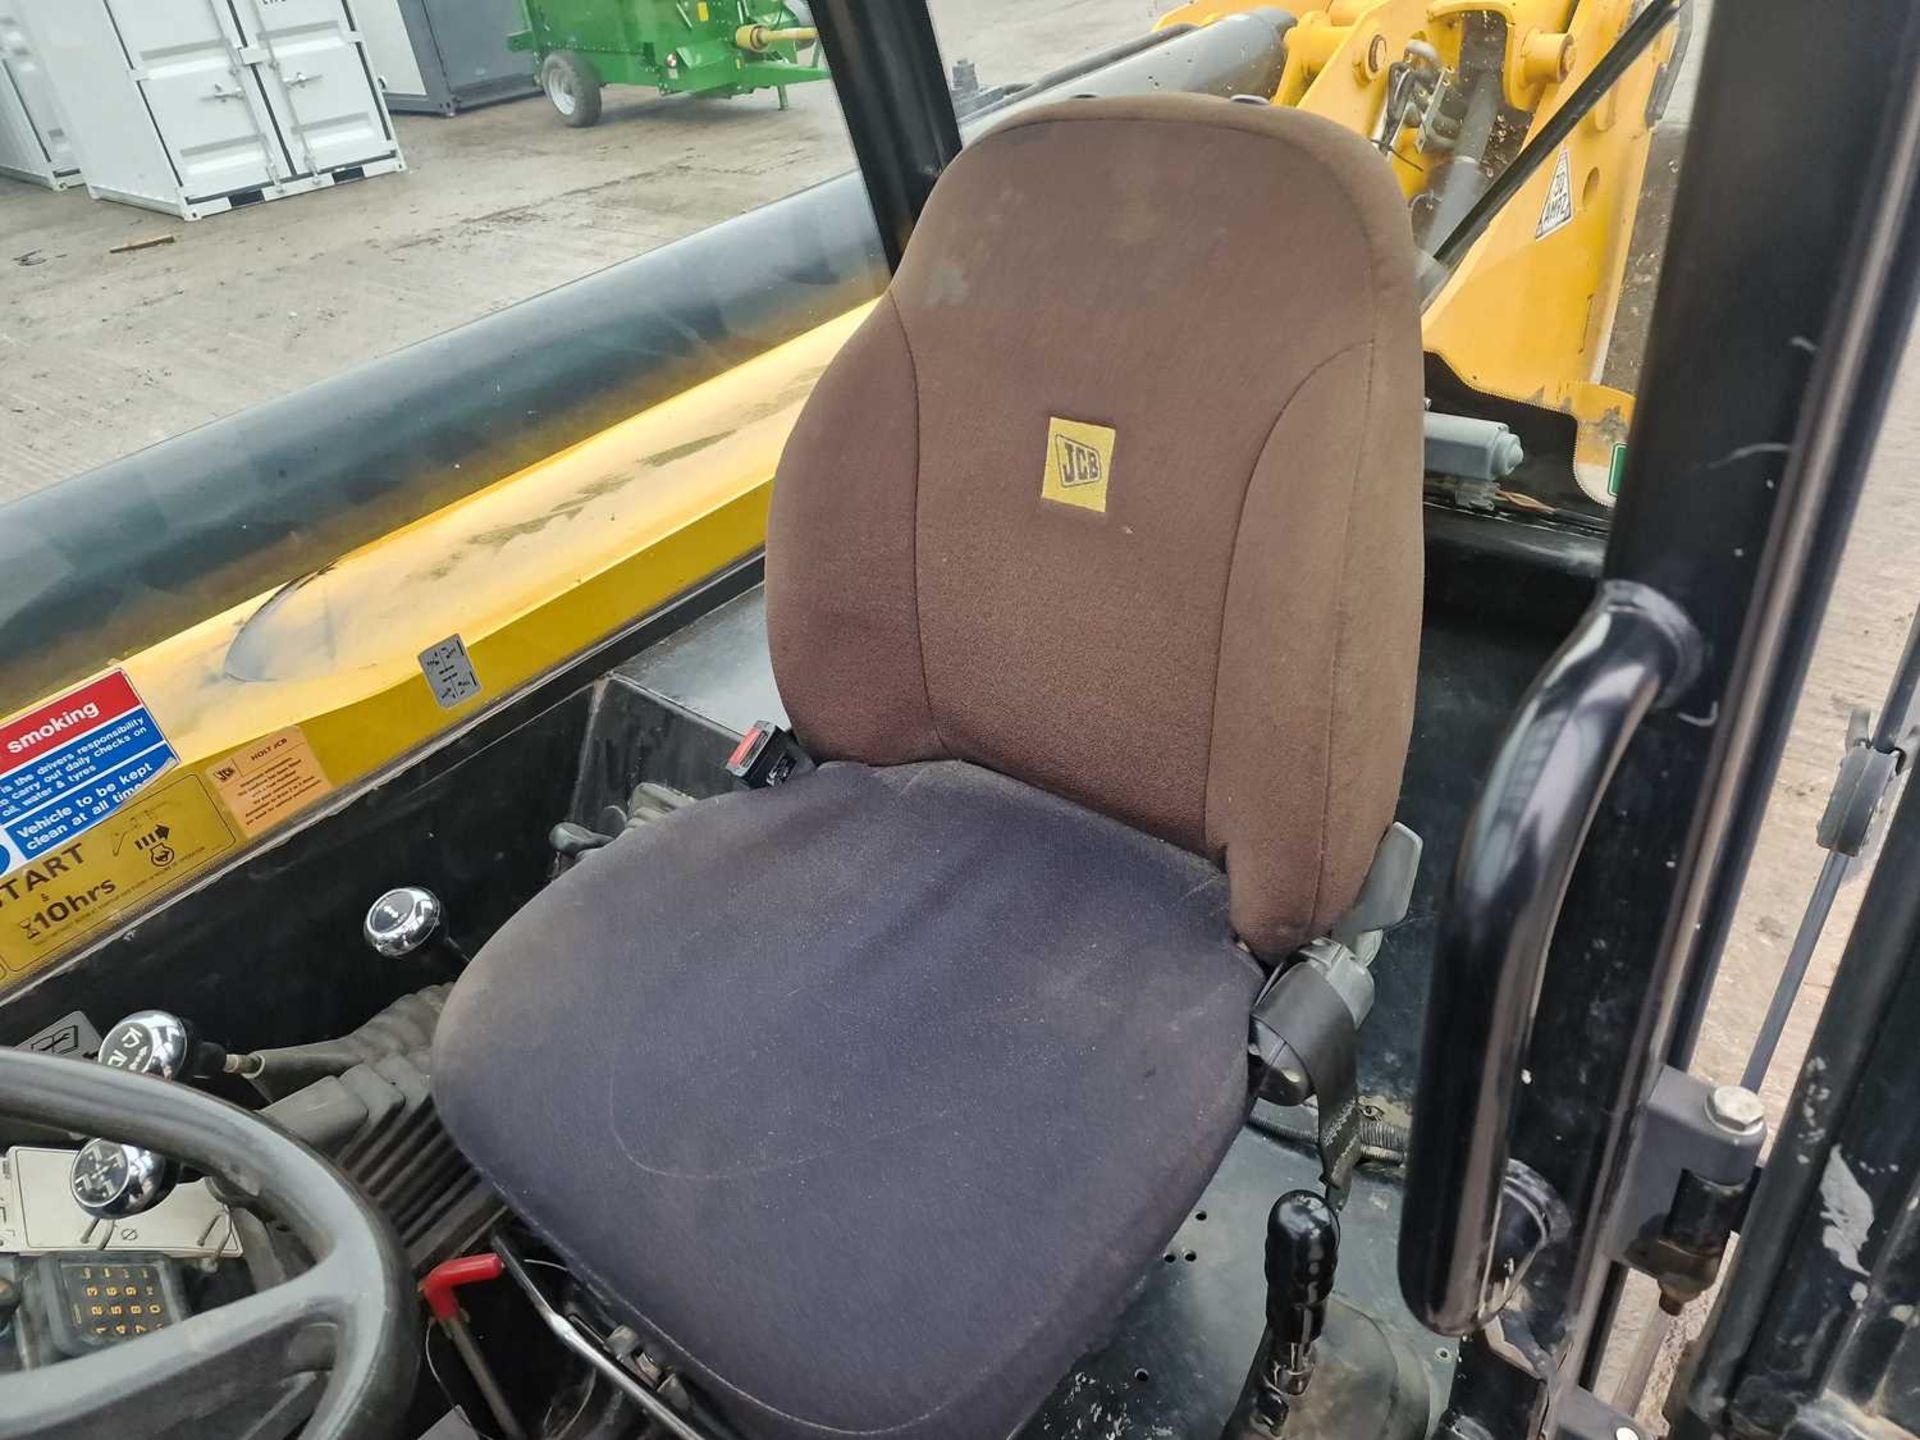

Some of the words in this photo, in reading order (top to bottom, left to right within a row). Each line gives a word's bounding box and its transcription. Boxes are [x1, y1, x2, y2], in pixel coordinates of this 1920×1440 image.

[1062, 441, 1099, 482] JCB
[7, 702, 100, 753] smoking
[12, 781, 41, 799] carry
[44, 769, 63, 783] out
[65, 756, 91, 772] daily
[94, 735, 131, 757] checks
[133, 726, 147, 737] on
[14, 774, 34, 787] the
[37, 753, 74, 775] drivers
[77, 716, 144, 755] responsibility
[250, 746, 272, 761] HOLT
[273, 738, 288, 750] JCB
[16, 807, 72, 838] Vehicle
[76, 796, 93, 808] to
[95, 783, 117, 798] be
[119, 762, 153, 785] kept
[22, 787, 52, 806] water
[56, 780, 66, 789] &
[67, 765, 96, 781] tyres
[26, 824, 68, 850] clean
[72, 812, 88, 827] at
[92, 799, 110, 815] all
[0, 842, 84, 908] TART
[86, 1286, 98, 1296] 3
[91, 1305, 102, 1315] 2
[106, 1286, 117, 1296] 6
[110, 1305, 122, 1315] 5
[125, 1286, 137, 1297] 9
[149, 1304, 161, 1314] 0
